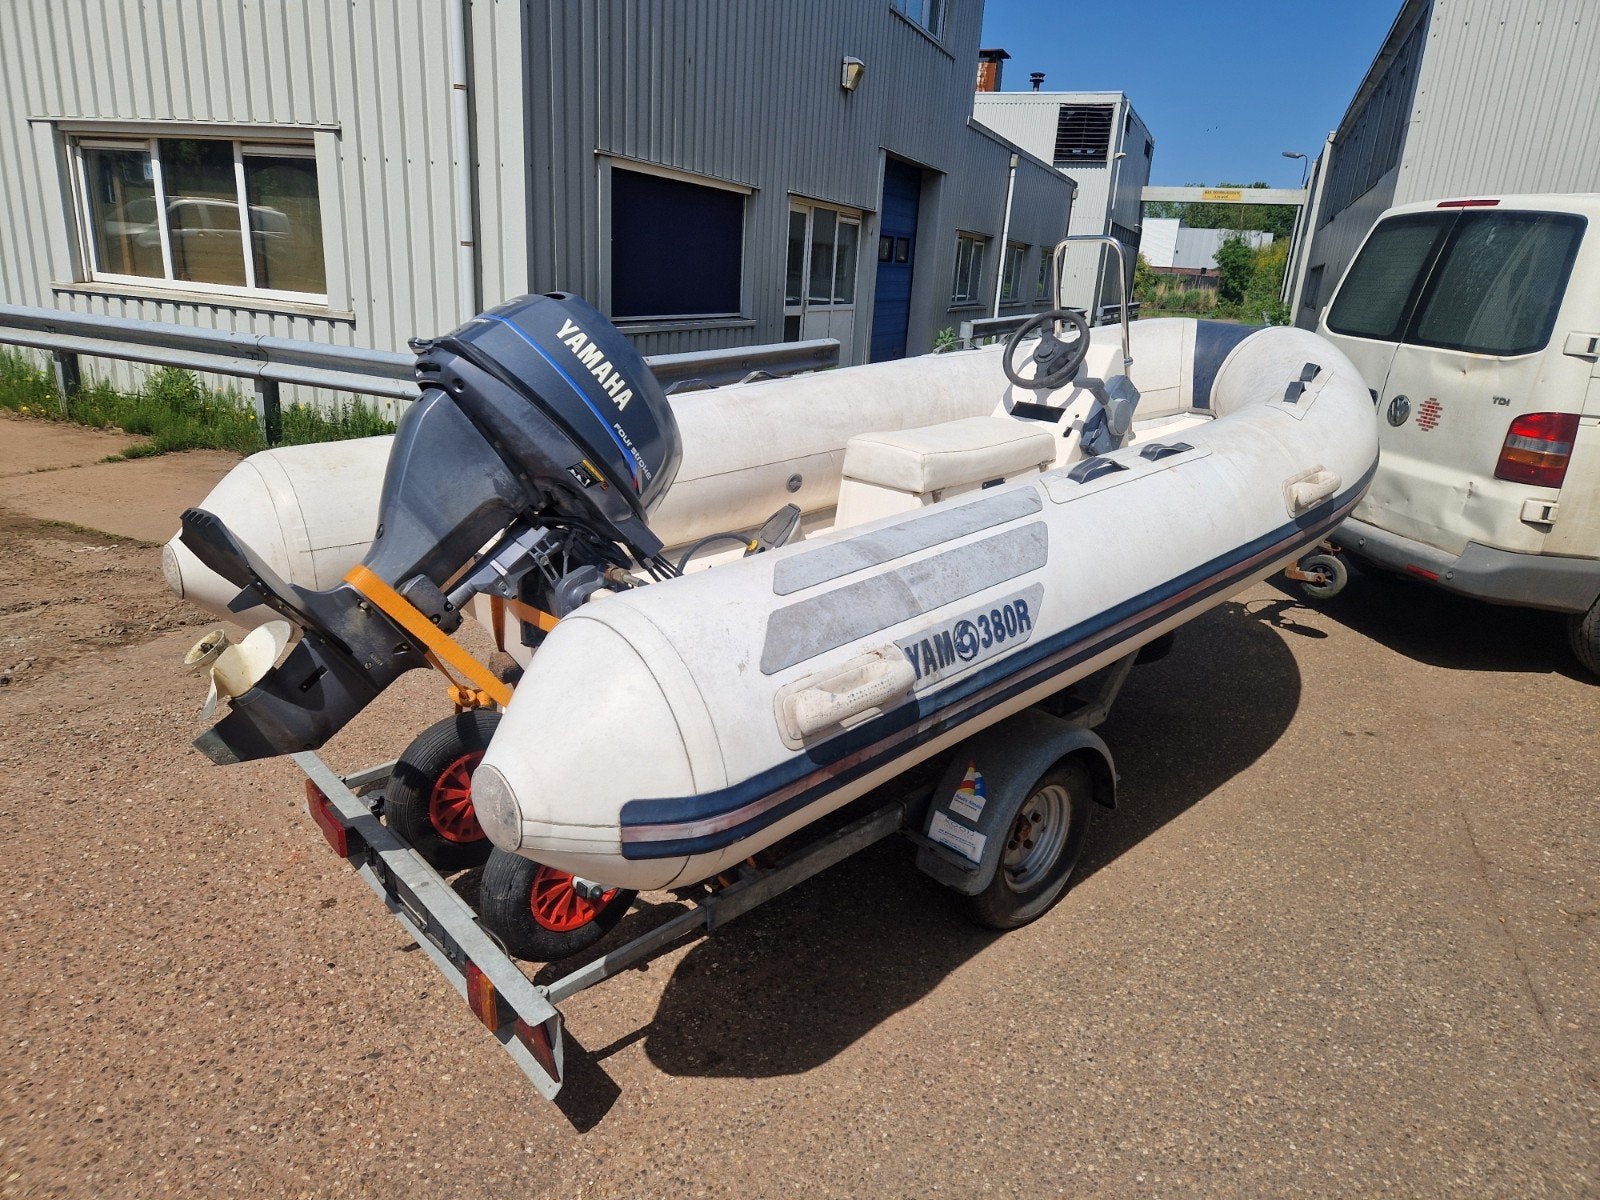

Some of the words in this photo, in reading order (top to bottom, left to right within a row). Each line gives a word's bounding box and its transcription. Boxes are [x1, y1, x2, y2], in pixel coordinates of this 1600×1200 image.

[556, 318, 633, 412] YAMAHA
[1492, 396, 1511, 406] TDI
[904, 630, 956, 680] YAM
[977, 598, 1032, 649] 380R
